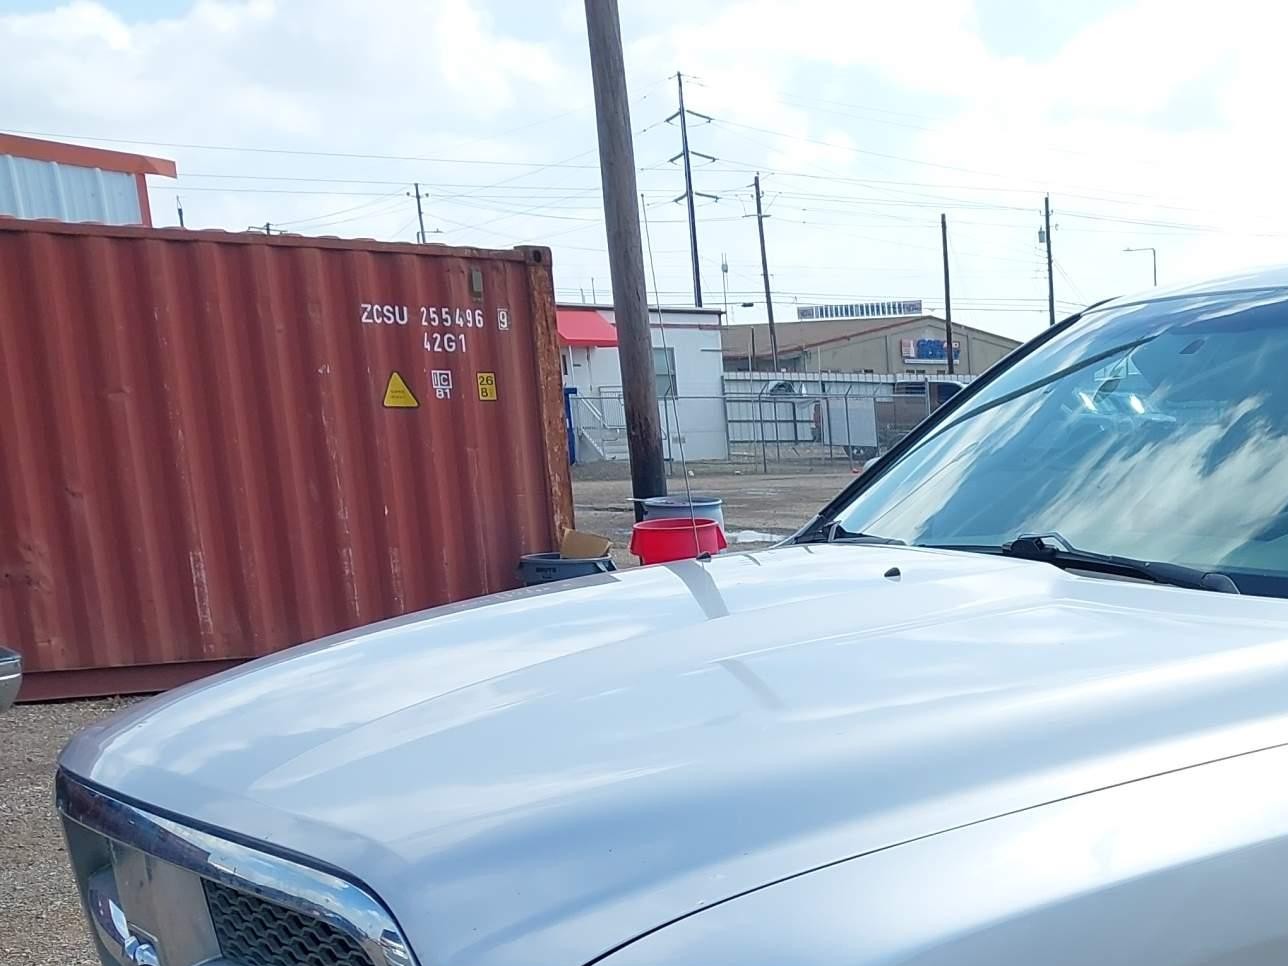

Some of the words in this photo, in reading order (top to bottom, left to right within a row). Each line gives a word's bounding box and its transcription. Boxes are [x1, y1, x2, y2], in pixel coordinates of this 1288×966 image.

[361, 304, 408, 324] ZCSU
[421, 307, 484, 328] 255496
[423, 332, 466, 352] 42G1
